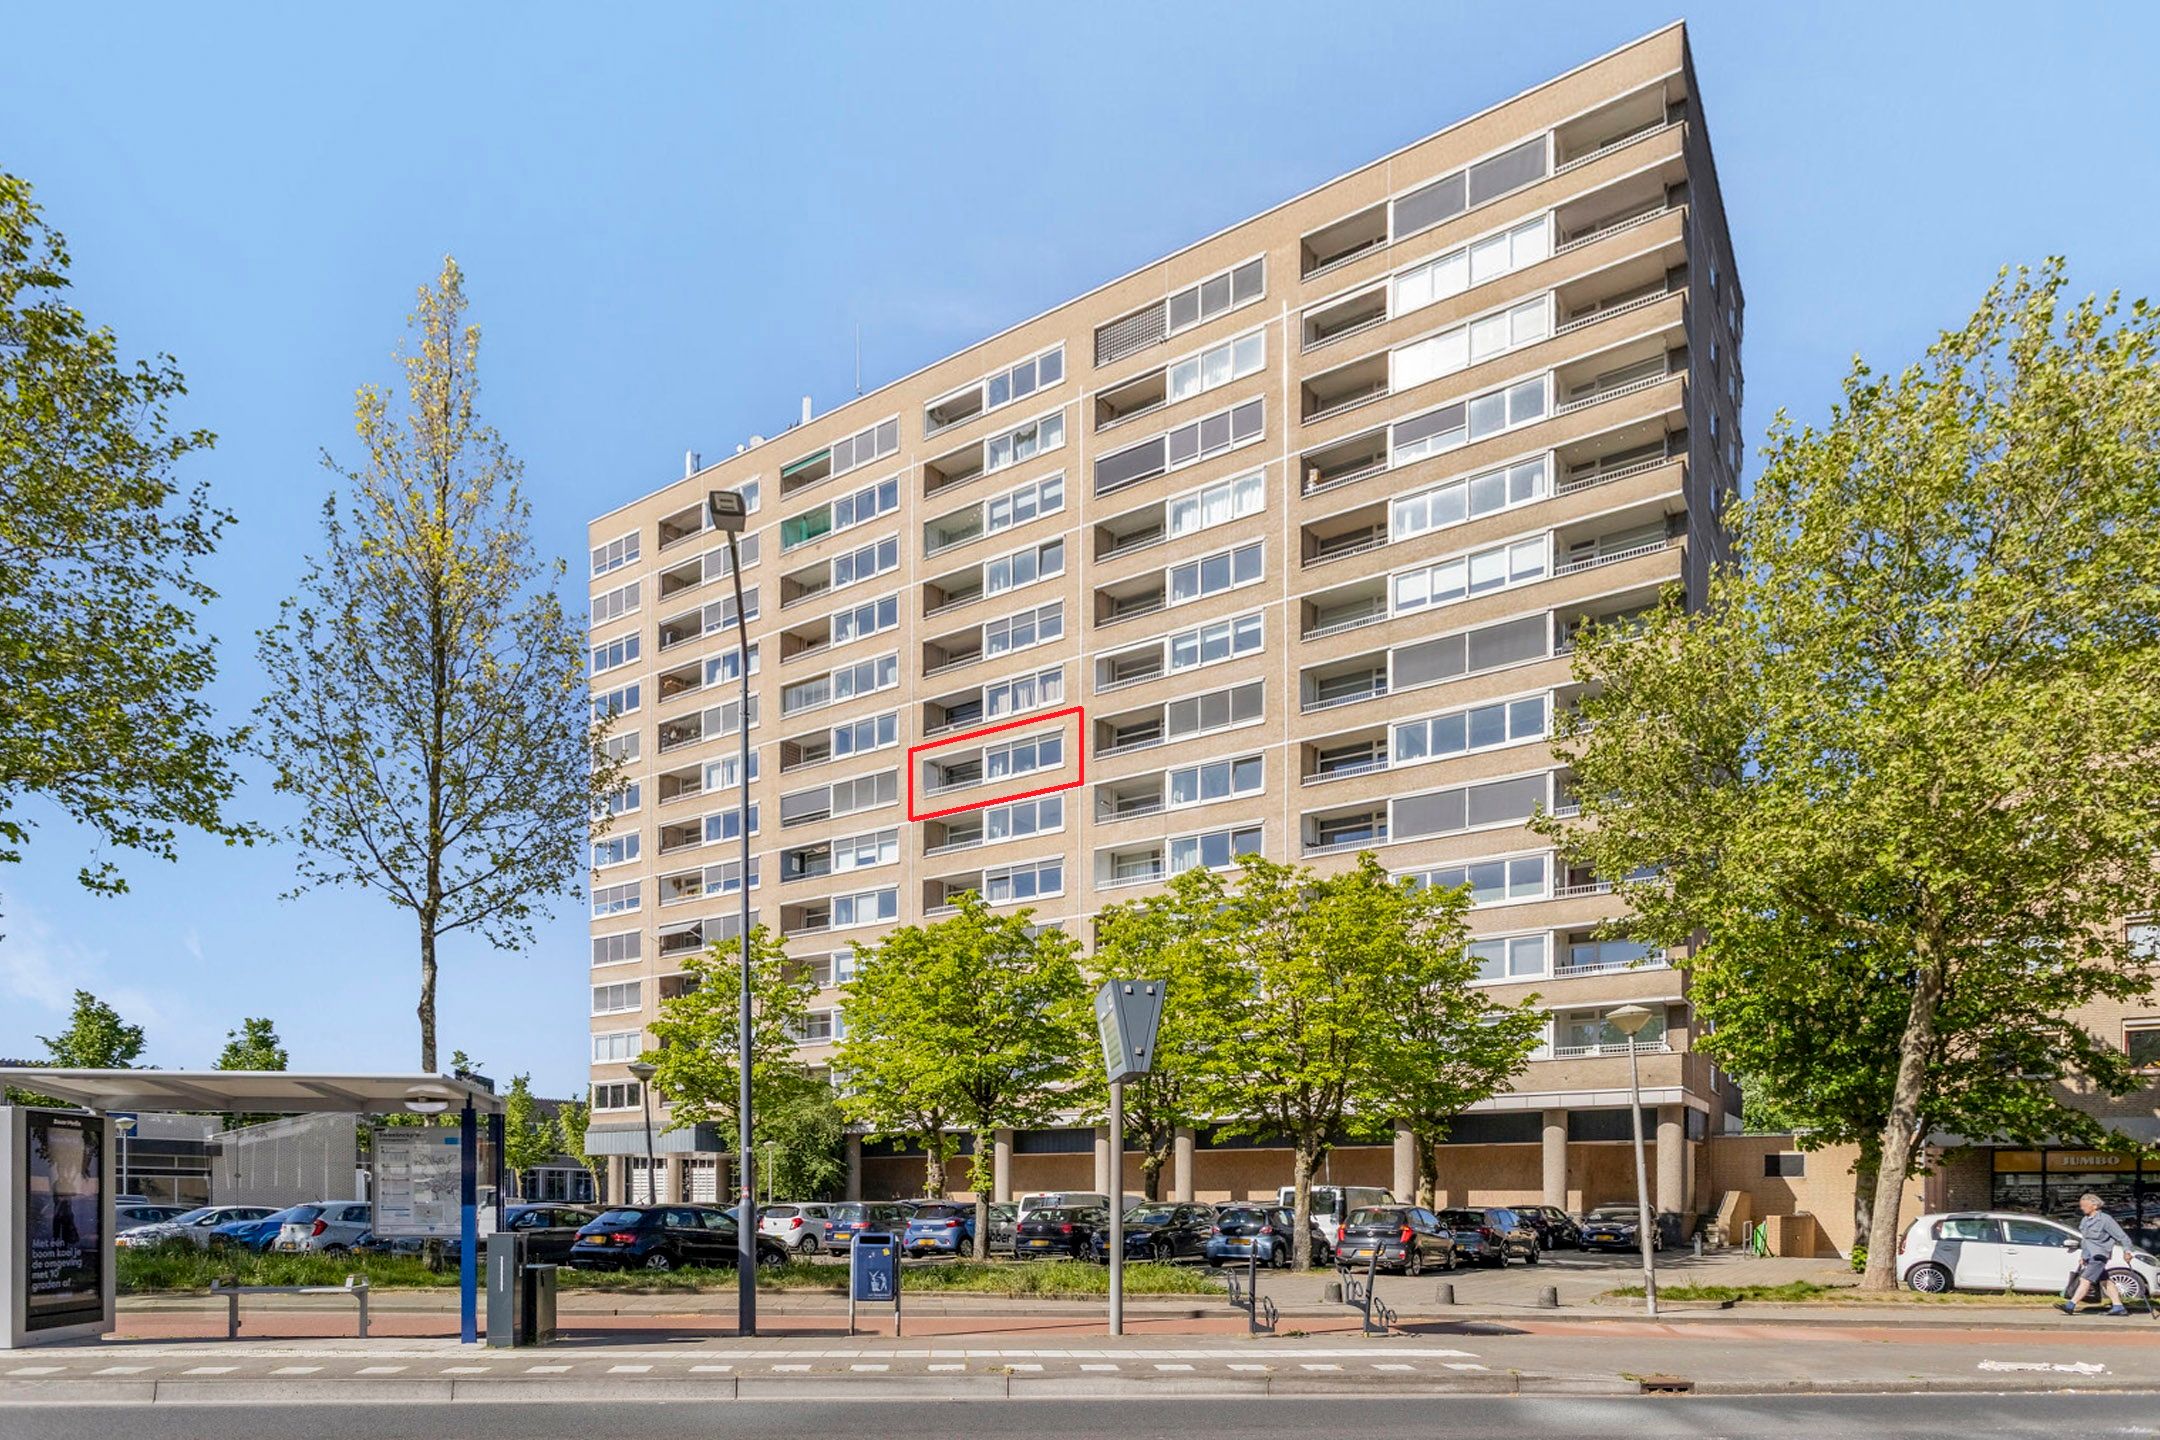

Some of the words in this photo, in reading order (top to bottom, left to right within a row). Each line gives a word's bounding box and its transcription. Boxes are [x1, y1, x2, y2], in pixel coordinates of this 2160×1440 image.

[2062, 1156, 2121, 1166] JUMBO
[32, 1239, 49, 1247] Met
[32, 1249, 55, 1258] boom
[73, 1247, 82, 1258] je
[31, 1260, 43, 1269] de
[44, 1259, 82, 1269] omgeving
[31, 1271, 49, 1279] met
[31, 1280, 61, 1292] graden
